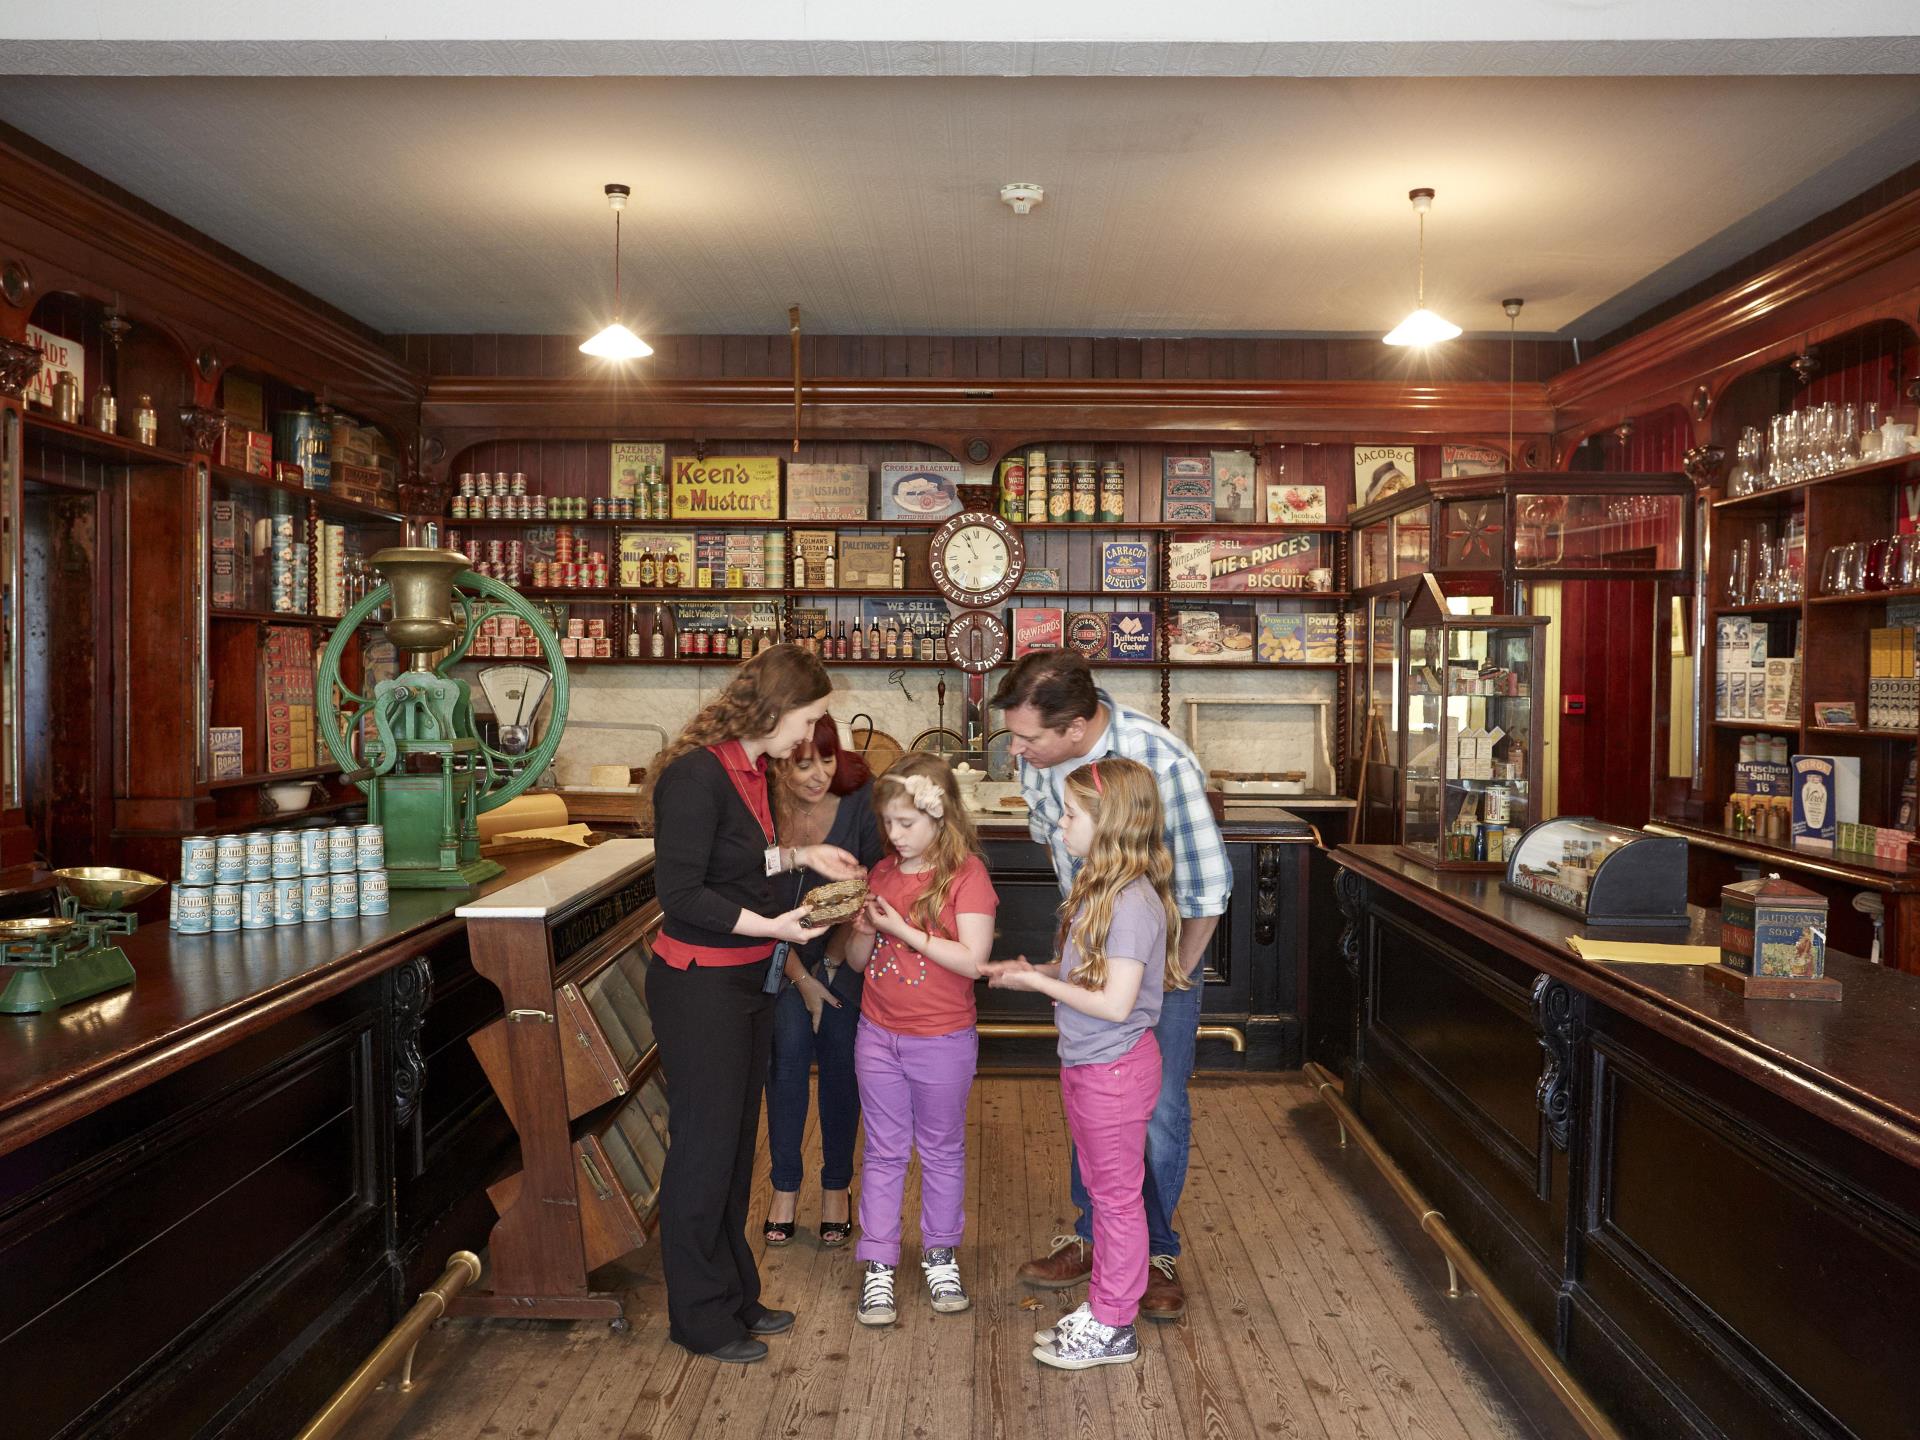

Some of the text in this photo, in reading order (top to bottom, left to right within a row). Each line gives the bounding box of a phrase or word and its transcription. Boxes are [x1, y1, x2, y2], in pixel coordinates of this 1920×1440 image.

[618, 455, 657, 464] PICKLES
[676, 462, 749, 484] Keen's
[690, 489, 773, 511] Mustard
[932, 512, 1007, 547] USE FRY'S
[1219, 540, 1242, 549] SELL
[1240, 557, 1249, 569] &
[1252, 536, 1311, 565] PRICE'S
[931, 560, 1021, 605] COFFEE ESSENCE
[1105, 574, 1146, 589] BISCUITS
[1170, 580, 1208, 589] BISCUITS
[887, 602, 936, 610] WE SELL
[679, 609, 724, 620] Malt Vinegar
[1017, 619, 1060, 643] CRAWFORD'S
[1119, 642, 1147, 653] Cracker
[1738, 763, 1789, 774] Kruschen
[1750, 772, 1776, 782] Salts
[1768, 927, 1796, 937] SOAP
